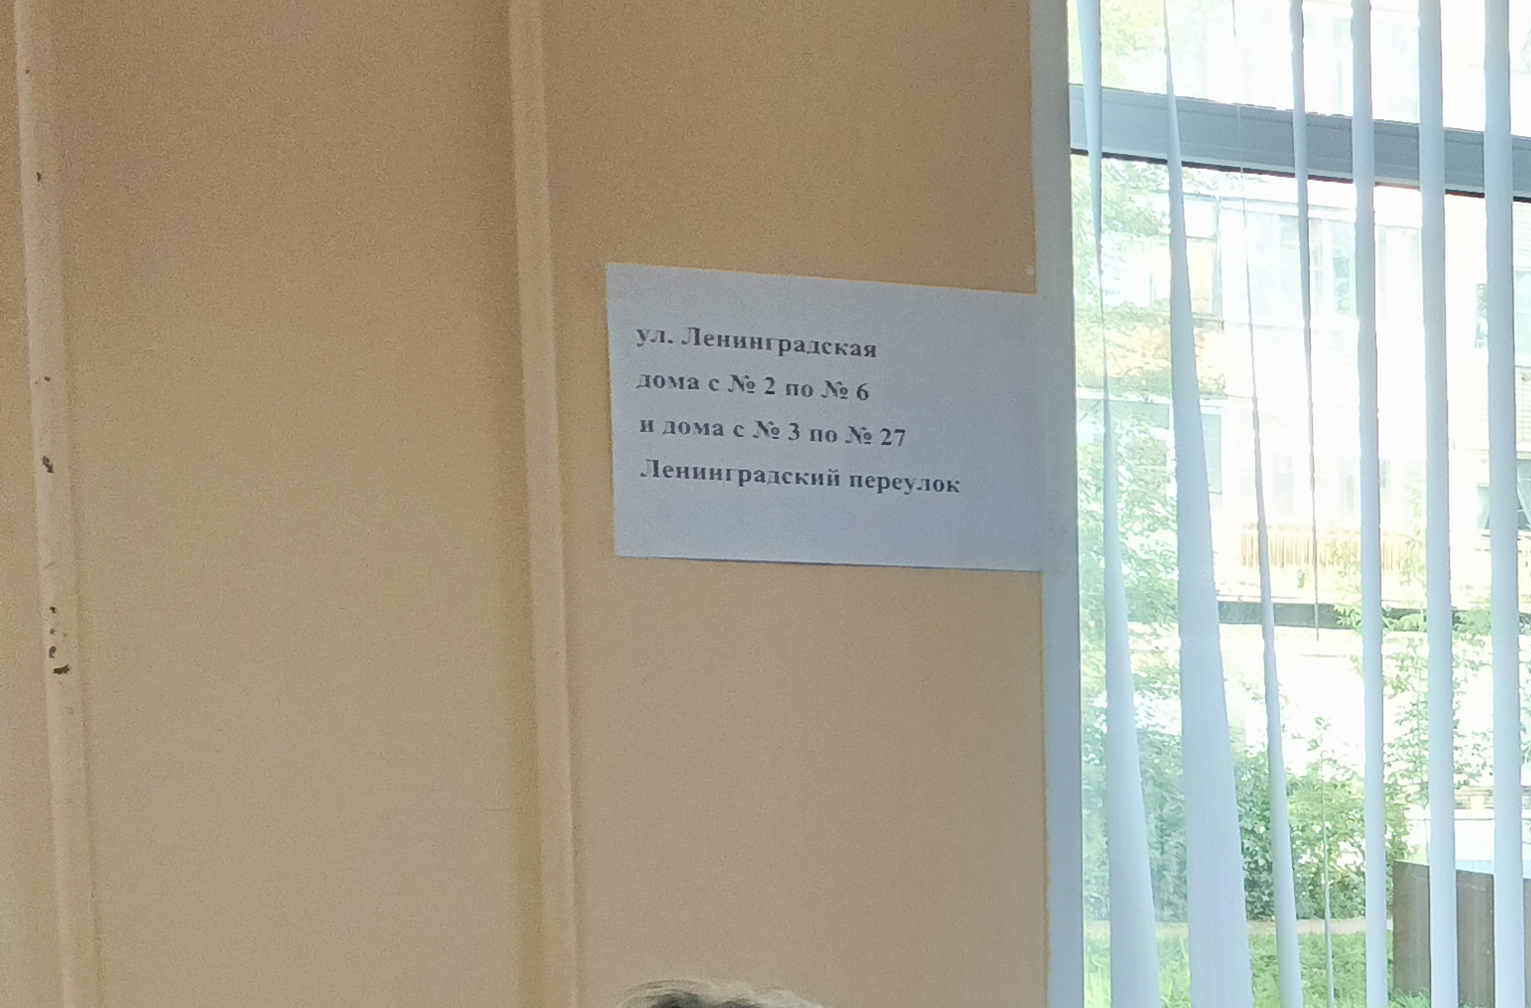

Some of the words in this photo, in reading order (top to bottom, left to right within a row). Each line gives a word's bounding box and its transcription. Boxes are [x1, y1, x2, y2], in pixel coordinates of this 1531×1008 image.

[636, 329, 673, 347] ул.
[681, 327, 876, 358] Ленинградская
[636, 374, 699, 389] дома
[708, 378, 719, 391] с
[728, 375, 755, 393] №
[764, 377, 775, 394] 2
[786, 384, 814, 397] по
[821, 380, 848, 399] №
[856, 383, 869, 400] 6
[640, 420, 653, 432] и
[662, 421, 724, 436] дома
[733, 425, 744, 437] с
[753, 420, 780, 439] №
[788, 423, 800, 440] 3
[810, 429, 837, 442] по
[845, 426, 872, 444] №
[880, 428, 905, 446] 27
[640, 459, 840, 487] Ленинградский
[850, 476, 960, 495] переулок
